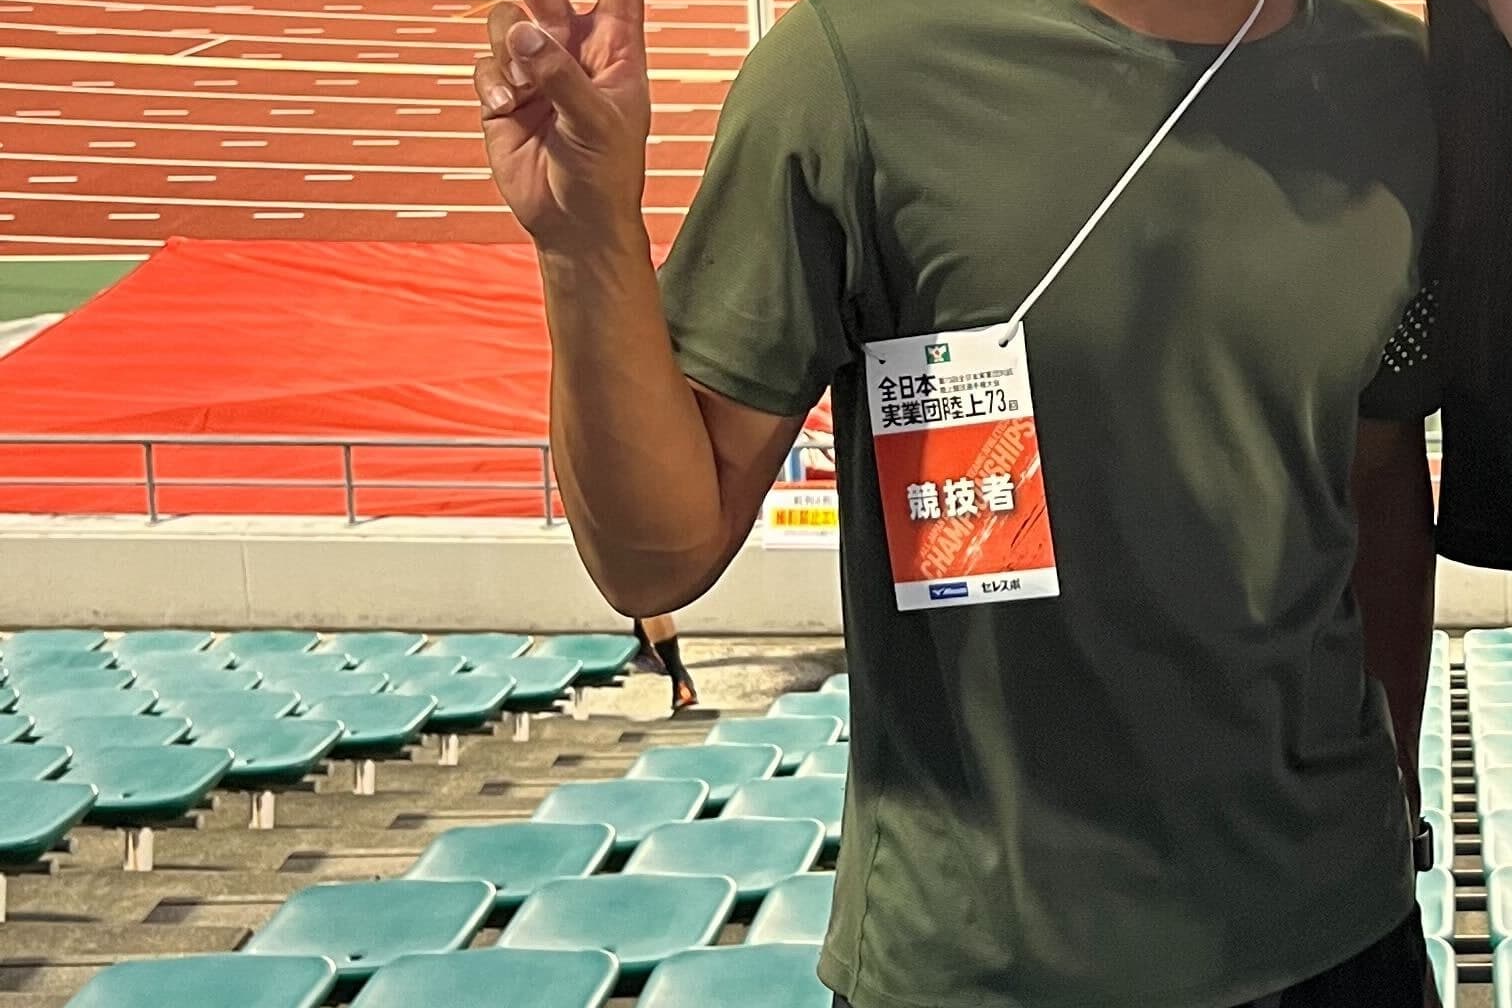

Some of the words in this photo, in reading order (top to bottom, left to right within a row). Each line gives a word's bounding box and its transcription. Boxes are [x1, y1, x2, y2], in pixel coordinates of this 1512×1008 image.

[878, 373, 937, 402] 全日本
[907, 473, 1015, 521] 競技者
[921, 420, 1033, 578] CHAMSHIPS
